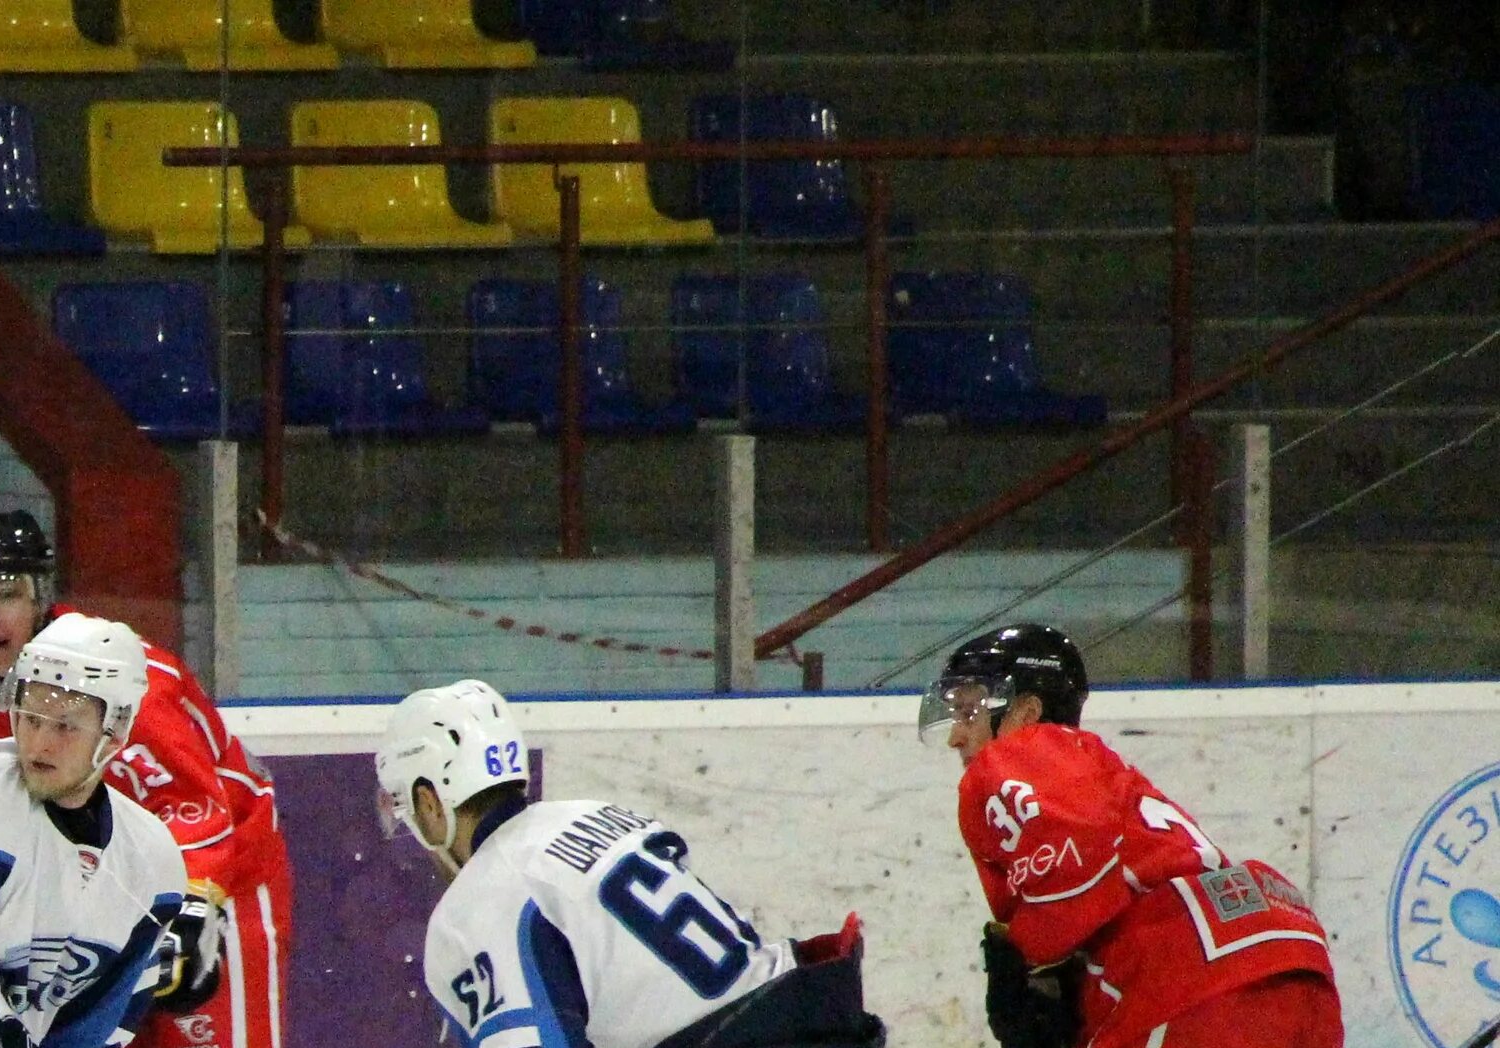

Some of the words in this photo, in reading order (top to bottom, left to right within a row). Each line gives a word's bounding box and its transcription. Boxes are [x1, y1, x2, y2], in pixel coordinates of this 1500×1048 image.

[109, 743, 174, 801] 23
[485, 741, 522, 777] 62
[984, 779, 1040, 853] 32
[1408, 790, 1500, 968] АРТЕЗ
